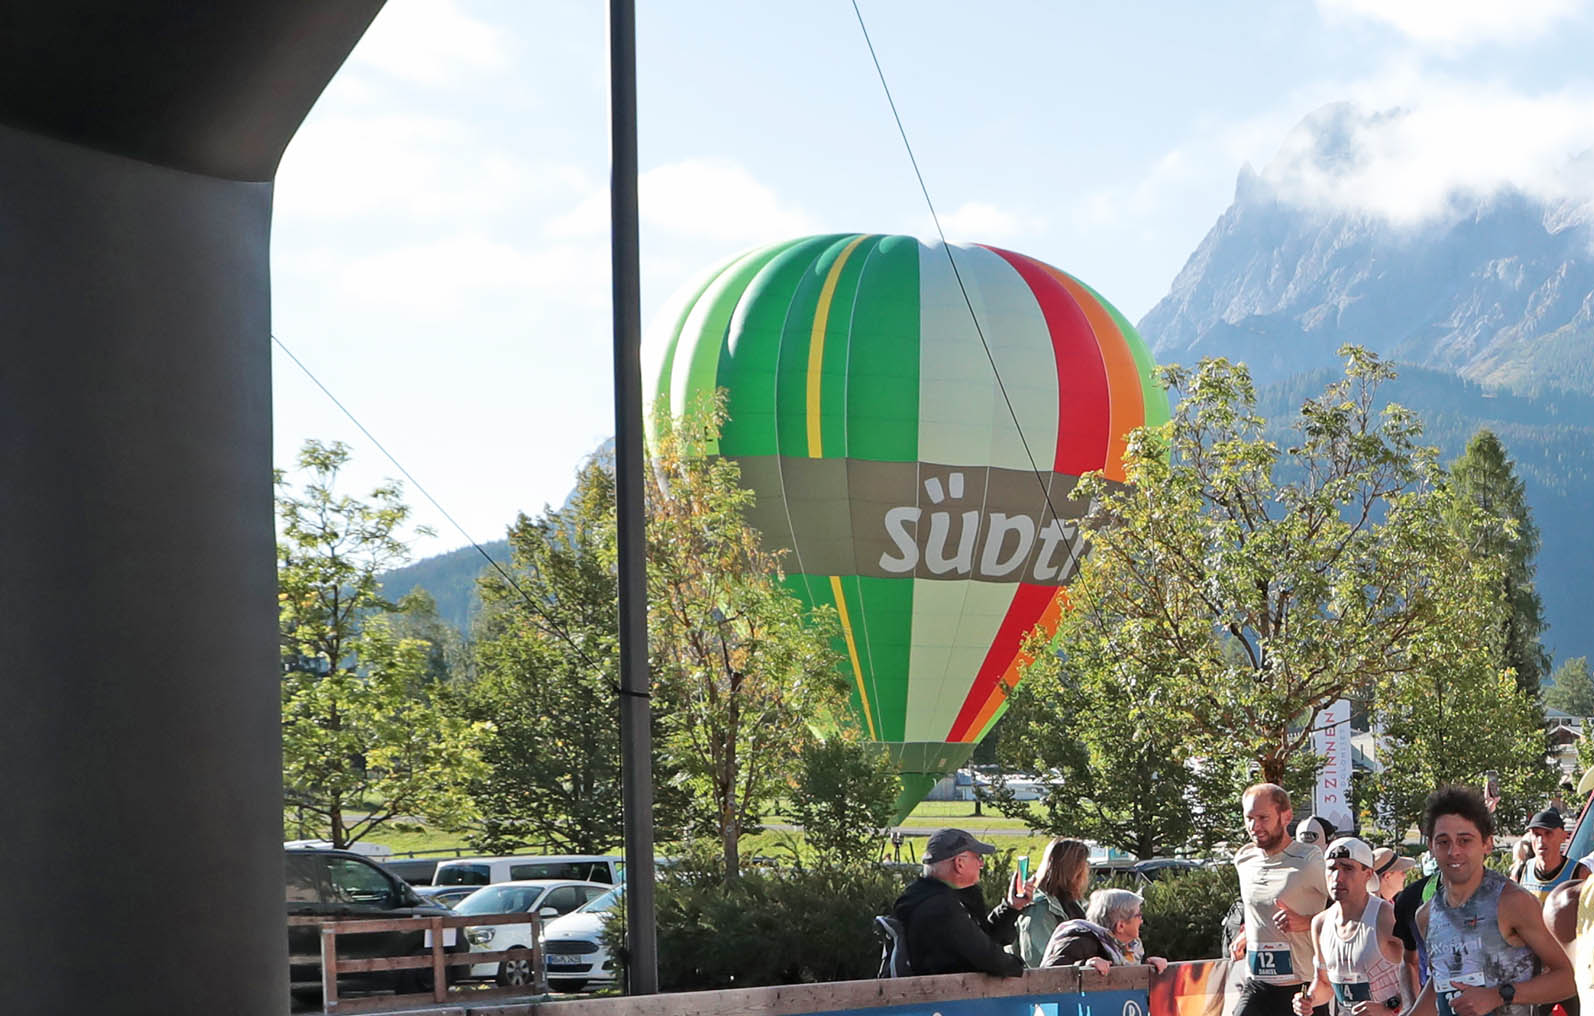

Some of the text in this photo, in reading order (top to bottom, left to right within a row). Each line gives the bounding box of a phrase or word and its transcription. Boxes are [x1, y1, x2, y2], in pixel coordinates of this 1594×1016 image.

[1324, 712, 1337, 789] ZINNEN
[1257, 952, 1276, 968] 12
[1343, 984, 1354, 1001] 4
